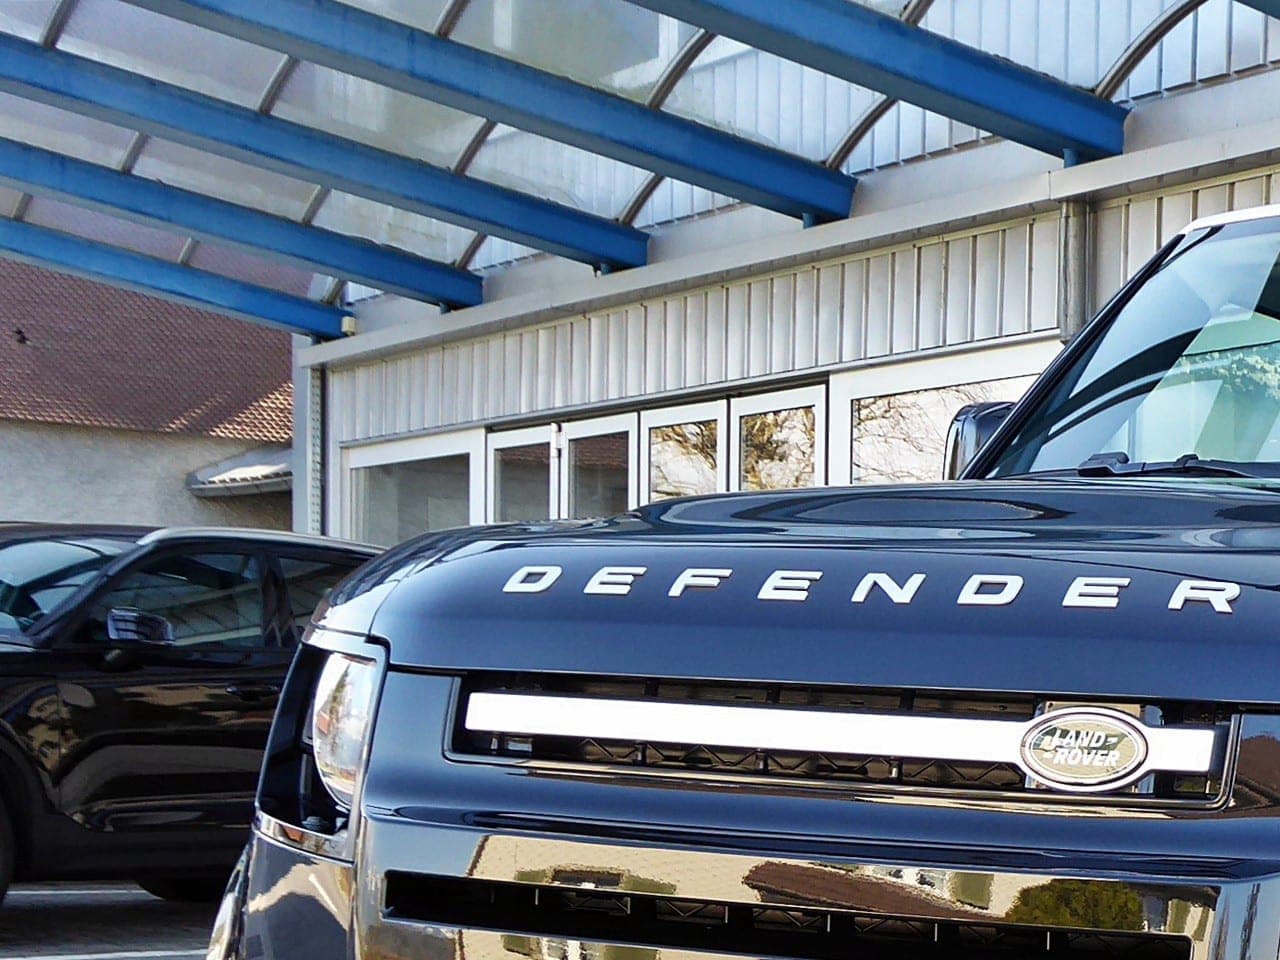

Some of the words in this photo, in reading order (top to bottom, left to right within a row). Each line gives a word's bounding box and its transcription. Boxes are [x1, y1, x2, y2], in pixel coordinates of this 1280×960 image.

[502, 565, 1242, 614] DEFENDER
[1053, 729, 1107, 748] LAND
[1053, 749, 1121, 767] ROVER
